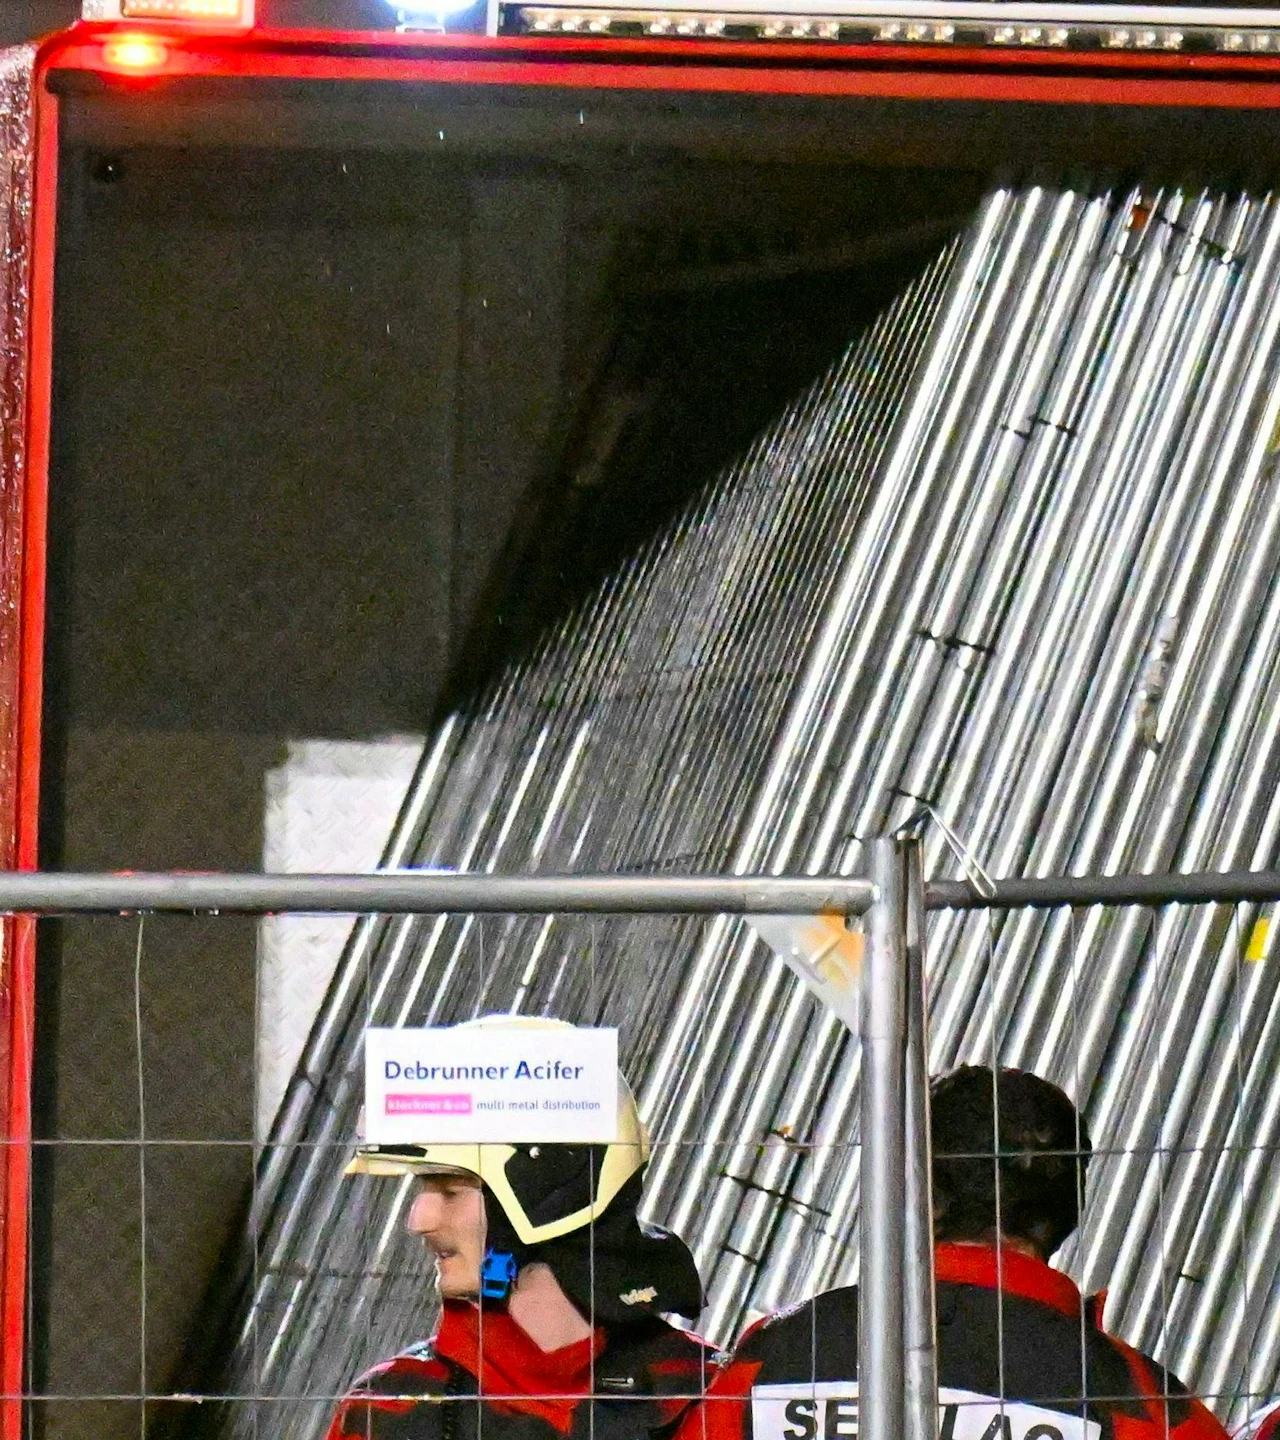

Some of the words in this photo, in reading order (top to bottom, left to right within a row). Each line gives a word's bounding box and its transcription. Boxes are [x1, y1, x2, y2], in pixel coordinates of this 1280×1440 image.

[384, 1060, 509, 1080] Debrunner
[513, 1060, 584, 1080] Acifer
[476, 1100, 505, 1111] multi
[508, 1099, 539, 1111] metal
[542, 1099, 601, 1111] distribution
